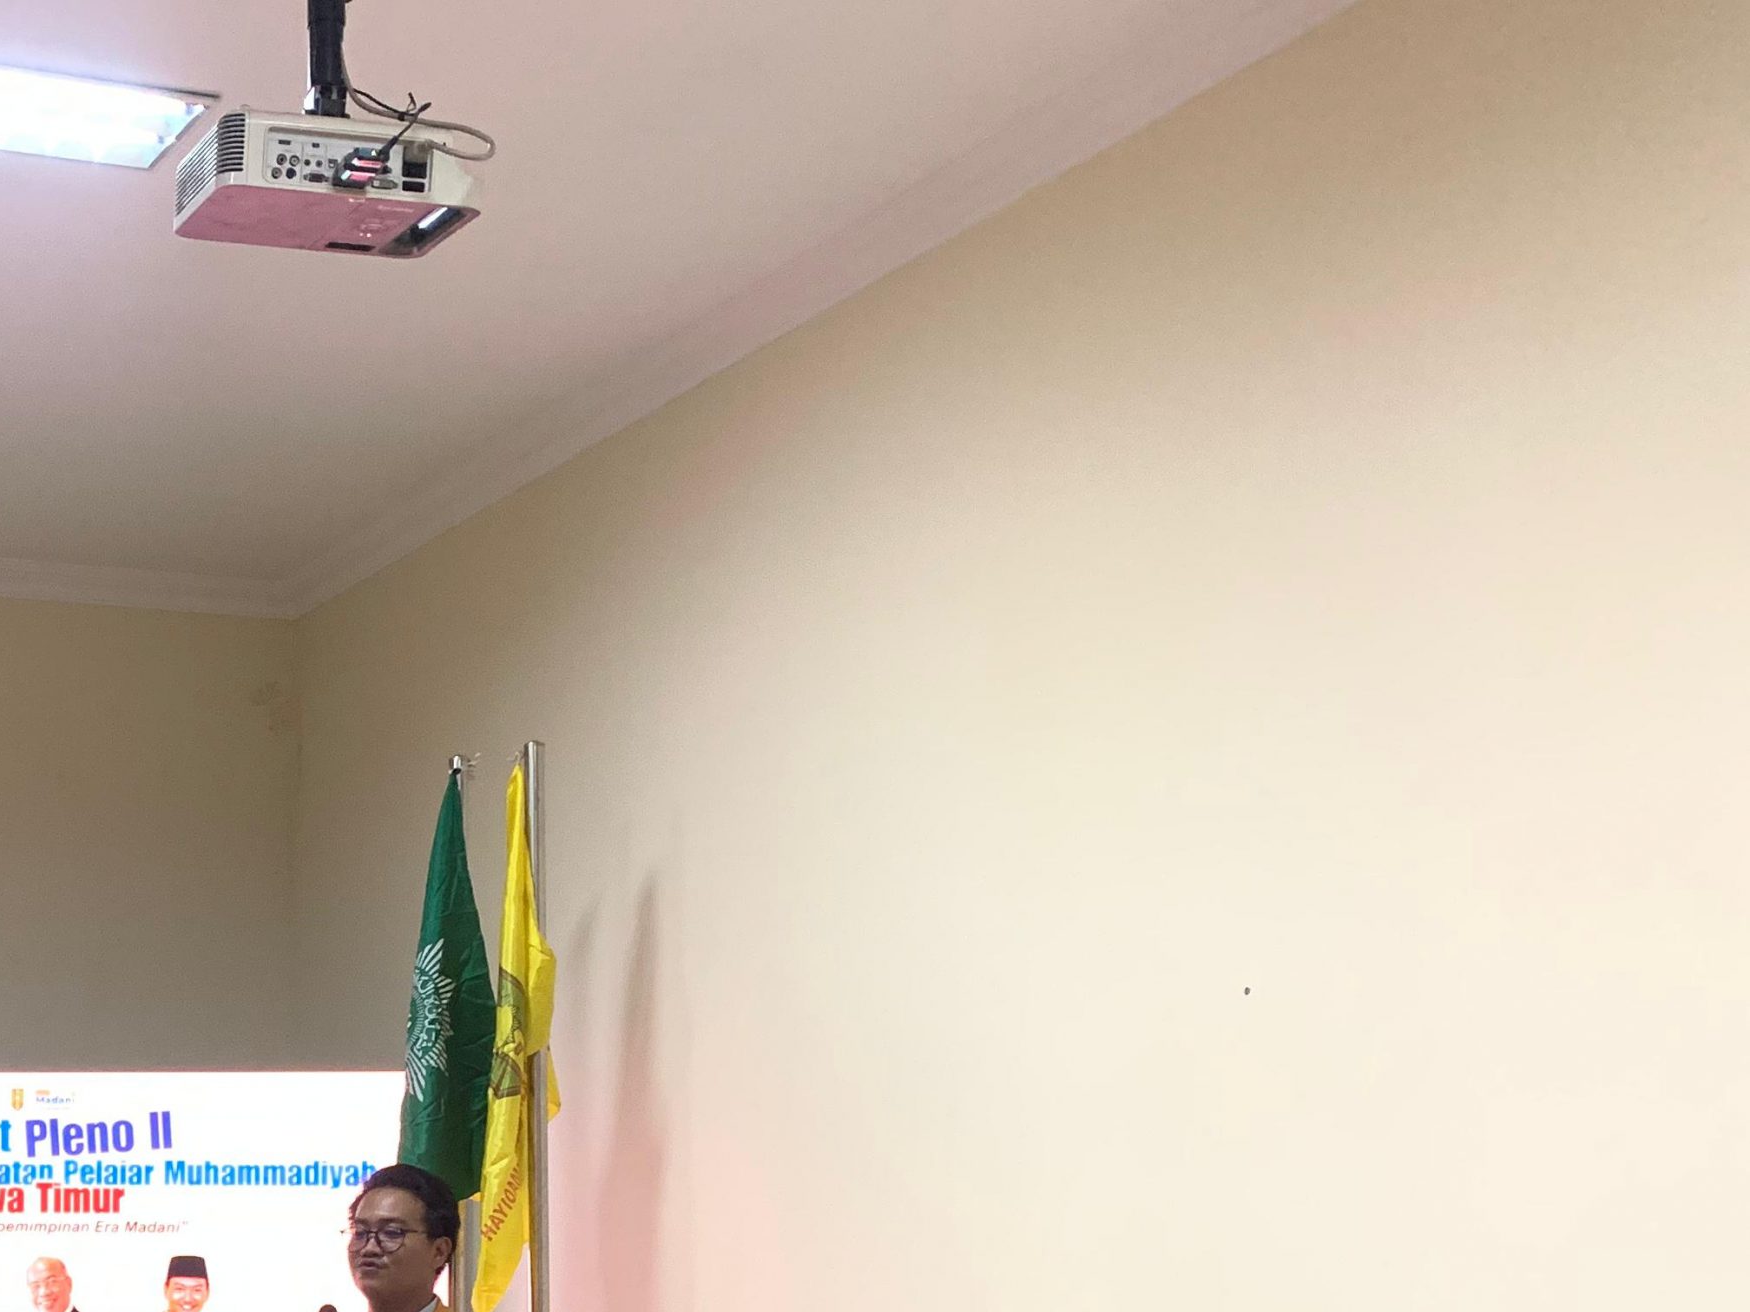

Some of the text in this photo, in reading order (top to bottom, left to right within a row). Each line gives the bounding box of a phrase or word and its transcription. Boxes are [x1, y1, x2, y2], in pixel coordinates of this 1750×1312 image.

[25, 1118, 135, 1158] Pleno
[149, 1110, 173, 1150] II
[164, 1160, 377, 1189] Muhammadiyah
[35, 1182, 126, 1213] Timur
[94, 1221, 120, 1233] Era
